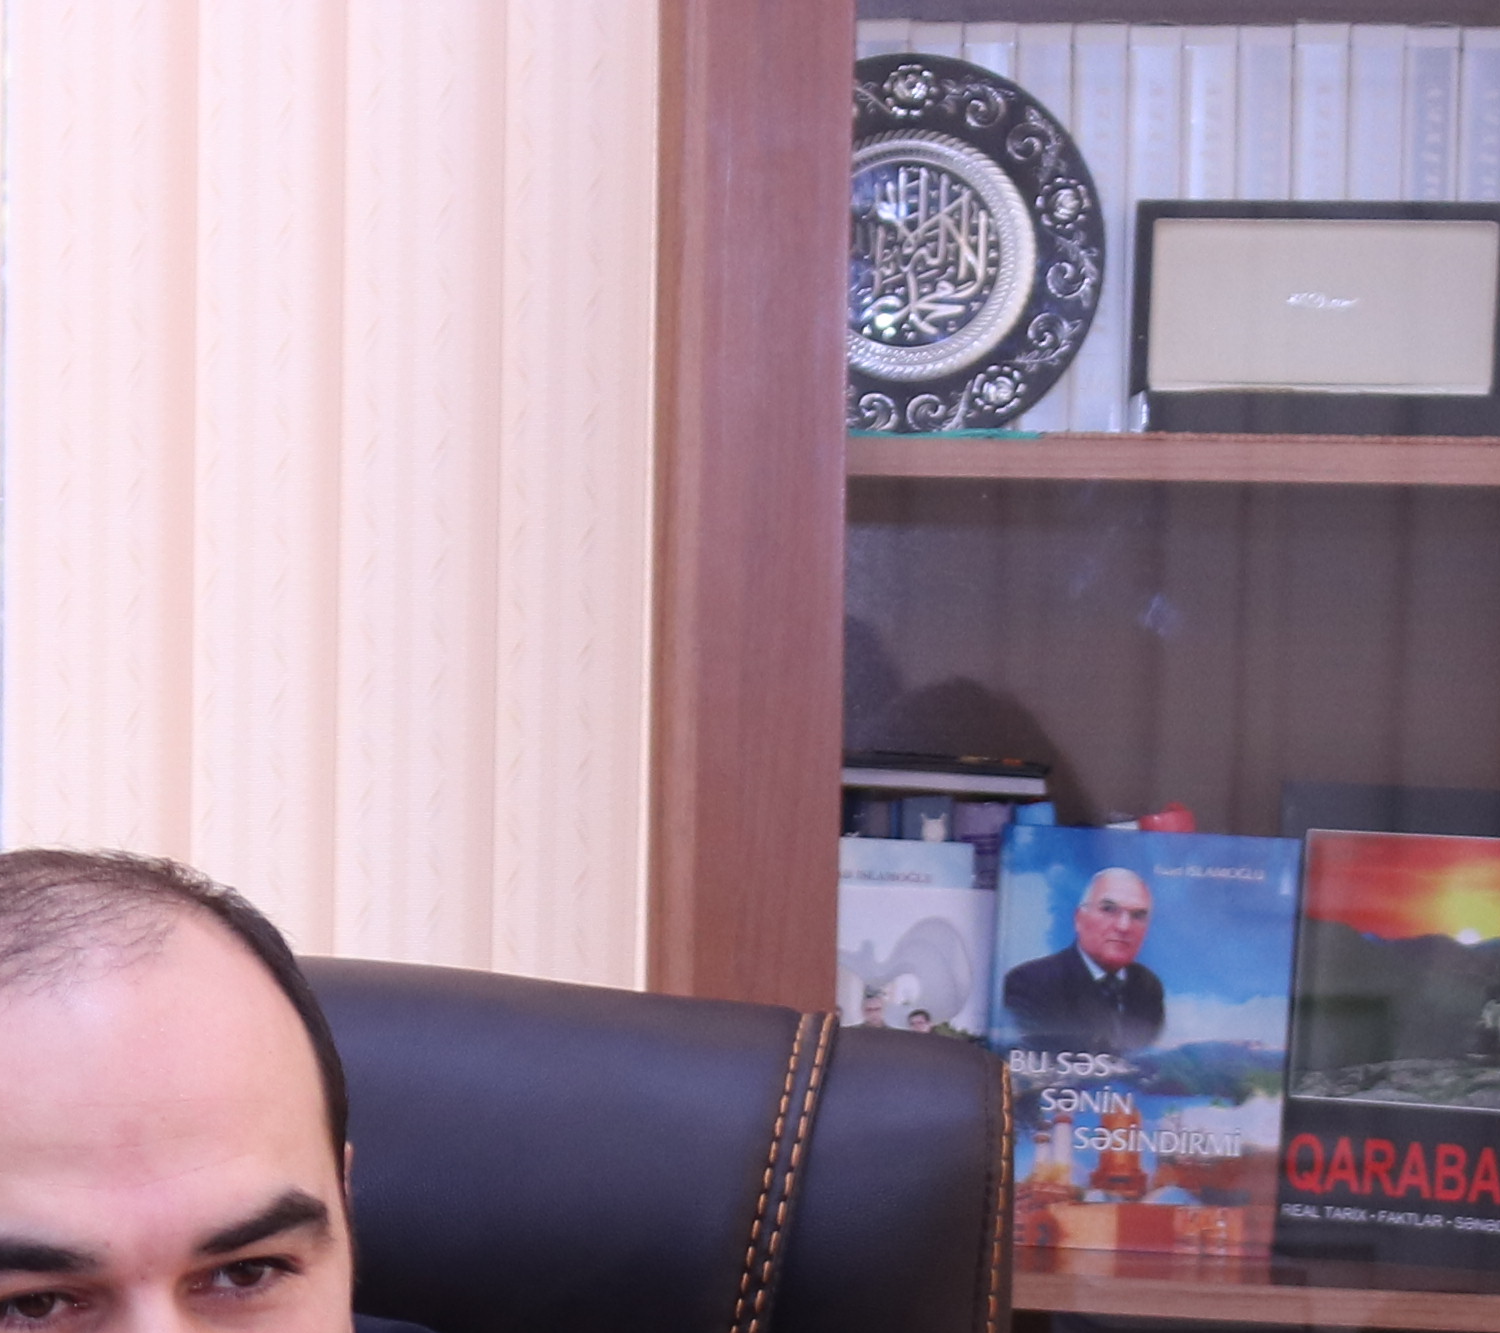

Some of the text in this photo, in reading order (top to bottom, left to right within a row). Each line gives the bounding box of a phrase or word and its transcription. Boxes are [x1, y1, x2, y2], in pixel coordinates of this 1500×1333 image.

[1009, 1049, 1111, 1076] BU SƏS
[1040, 1086, 1133, 1115] SƏNİN
[1073, 1124, 1242, 1157] SƏSİNDİRMİ
[1281, 1203, 1320, 1218] REAL
[1377, 1210, 1443, 1228] FAKTLAR
